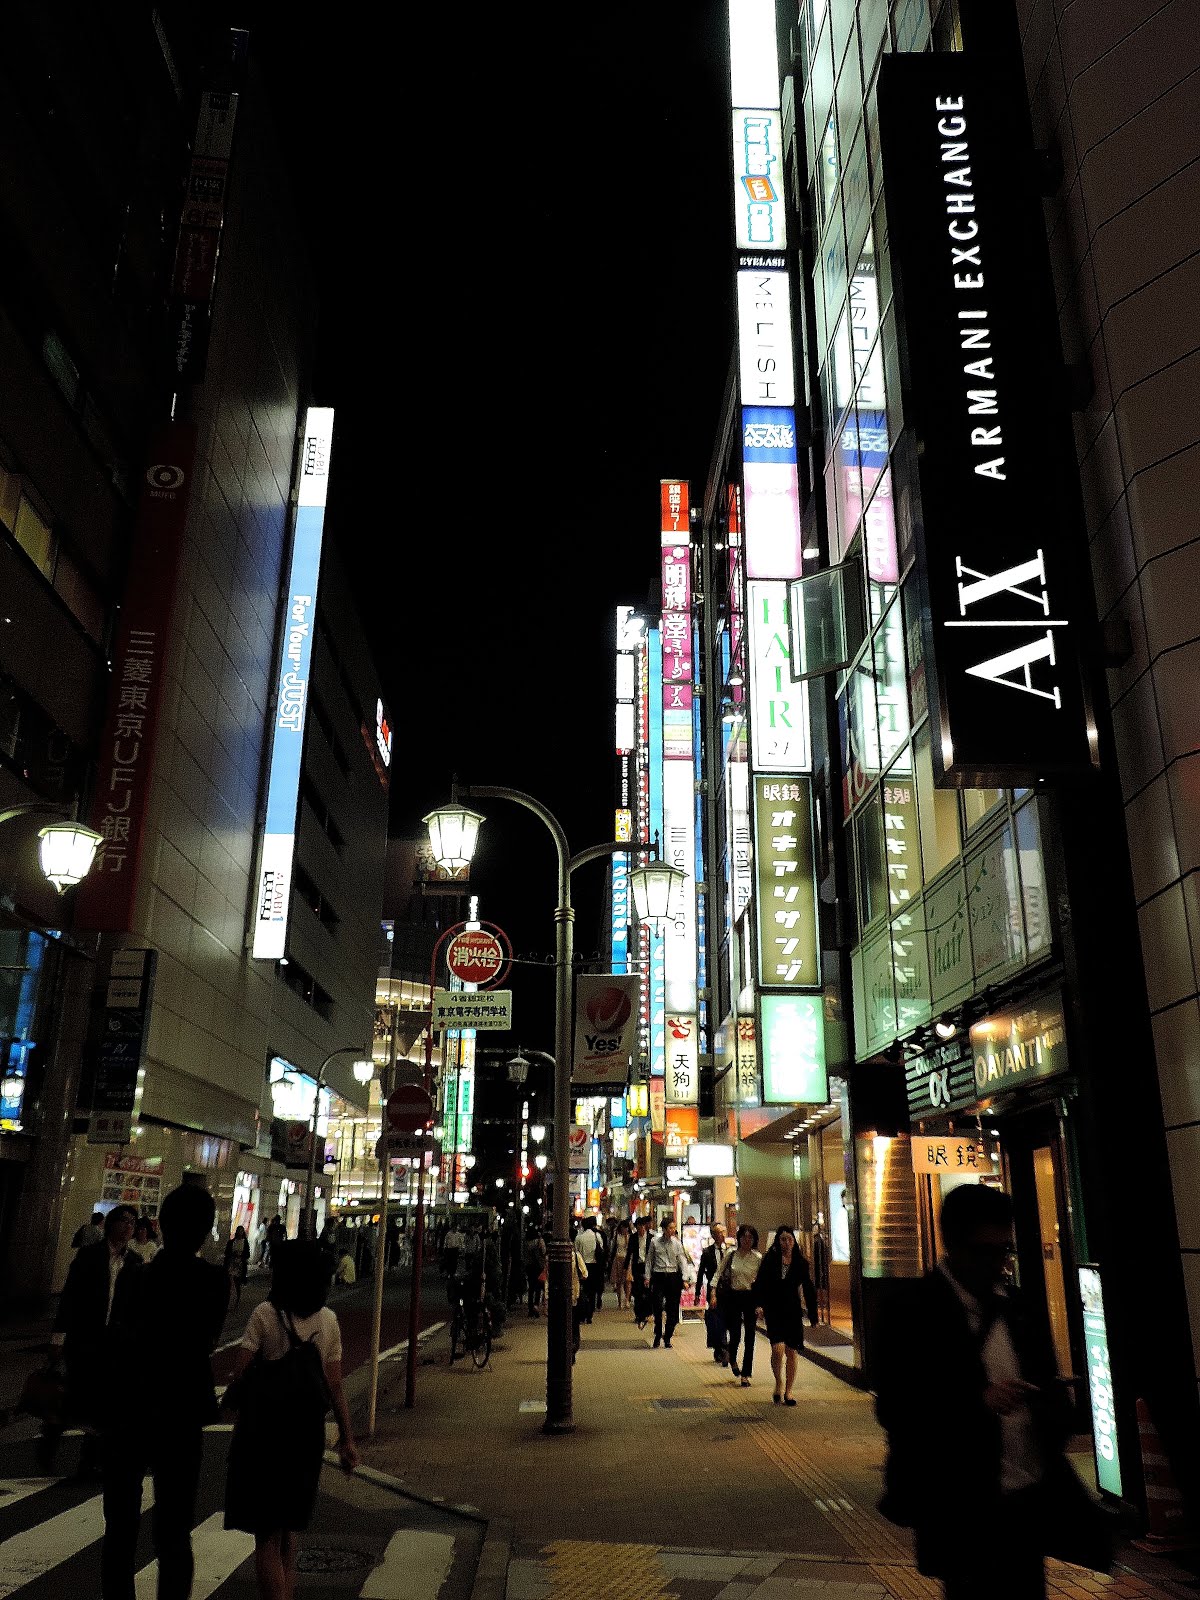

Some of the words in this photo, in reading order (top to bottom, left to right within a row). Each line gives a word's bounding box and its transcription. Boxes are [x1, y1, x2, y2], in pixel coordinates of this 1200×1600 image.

[936, 97, 984, 288] EXCHANGE
[740, 257, 785, 267] EYELASH
[754, 276, 776, 399] MELISH
[958, 311, 1006, 480] ARMANI
[668, 484, 682, 531] 銀座カラー
[278, 672, 307, 731] JUST
[96, 630, 156, 875] 三菱東京UFJ銀行
[763, 784, 801, 802] 眼鏡
[453, 946, 498, 967] 消火栓
[438, 1006, 507, 1017] 東京電子専門学校
[585, 1035, 622, 1051] Yes!
[672, 1054, 690, 1088] 天狗
[927, 1144, 979, 1168] 眼鏡
